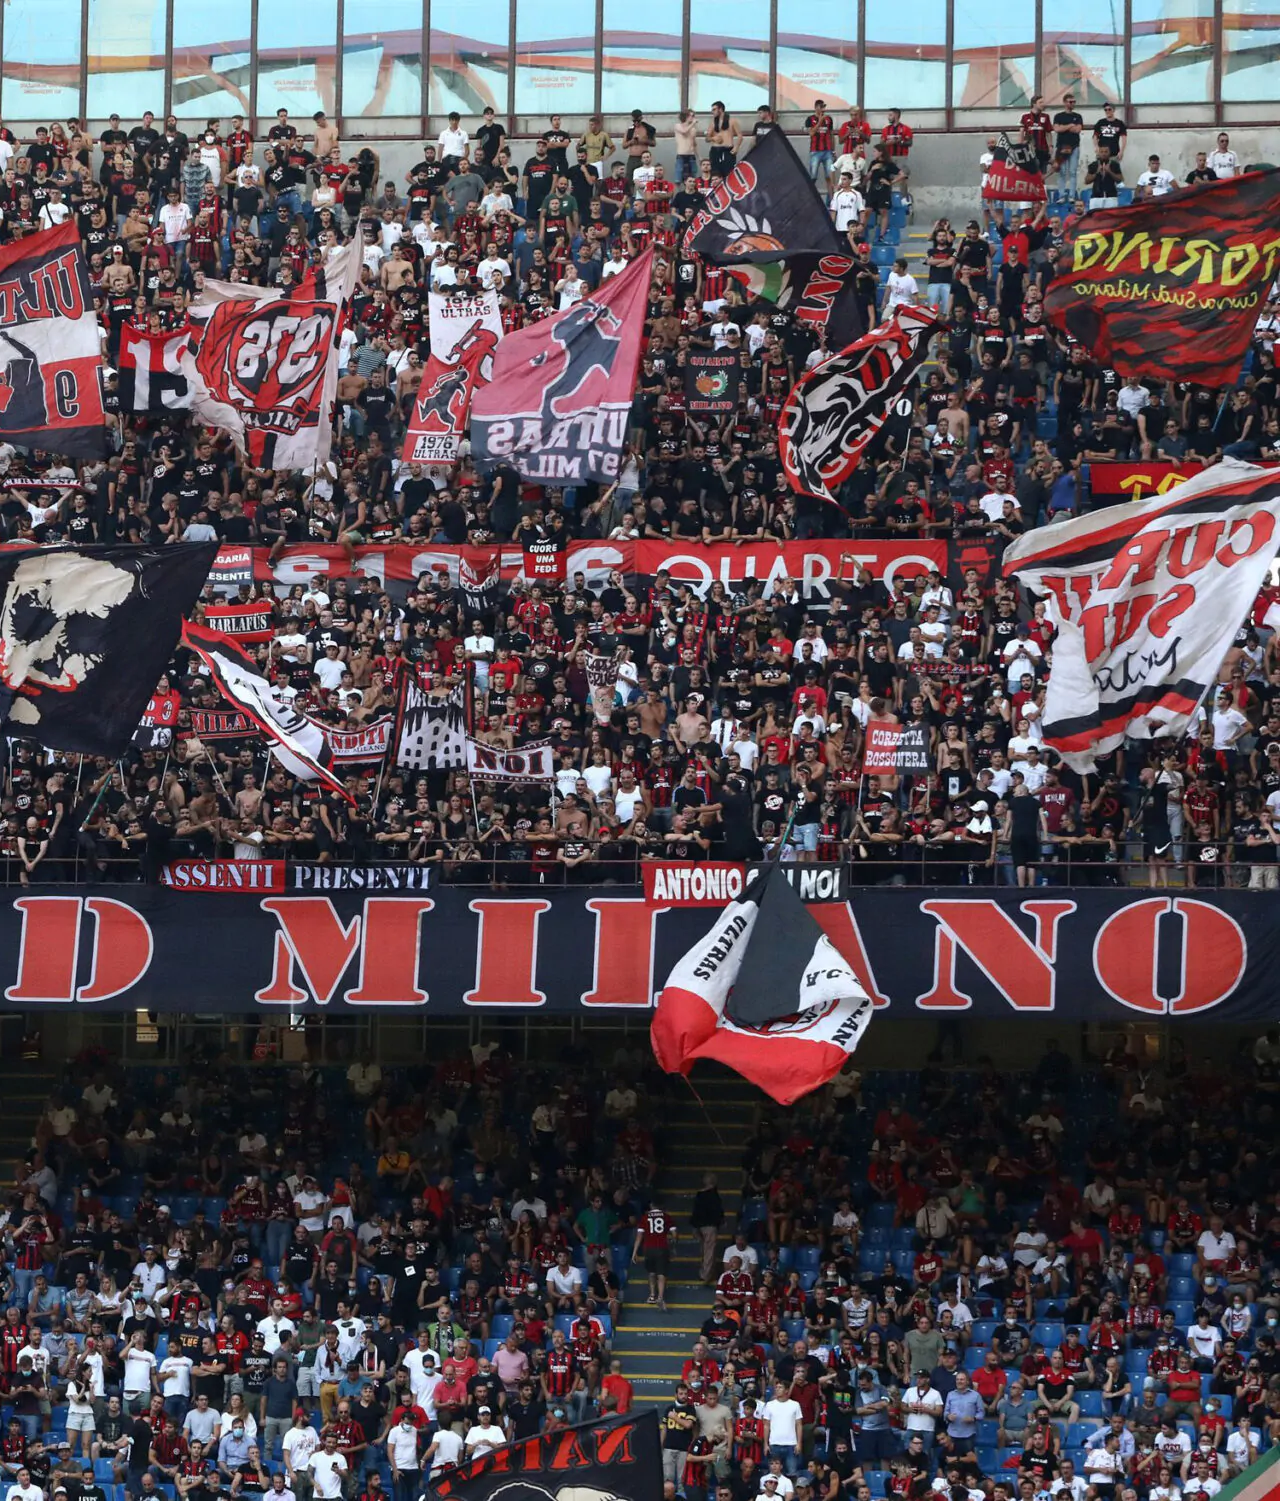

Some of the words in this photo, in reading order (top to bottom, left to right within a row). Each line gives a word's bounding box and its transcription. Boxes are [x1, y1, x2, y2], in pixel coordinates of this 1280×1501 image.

[440, 305, 492, 319] ULTRAS
[690, 356, 736, 367] QUARTO
[690, 401, 733, 410] MILANO
[421, 436, 453, 449] 1976
[413, 448, 458, 460] ULTRAS
[529, 543, 558, 553] CUORE
[212, 553, 250, 564] GARIA
[535, 554, 555, 564] UNA
[534, 564, 558, 574] FEDE
[207, 572, 251, 582] ESENTE
[872, 729, 924, 746] CORBETTA
[474, 751, 545, 775] NOI
[865, 750, 928, 767] ROSSONERA
[159, 864, 275, 888] ASSENTI
[294, 866, 431, 890] PRESENTI
[653, 867, 743, 900] ANTONIO
[799, 867, 842, 900] NOI
[694, 915, 748, 981] ULTRAS
[647, 1217, 665, 1234] 18
